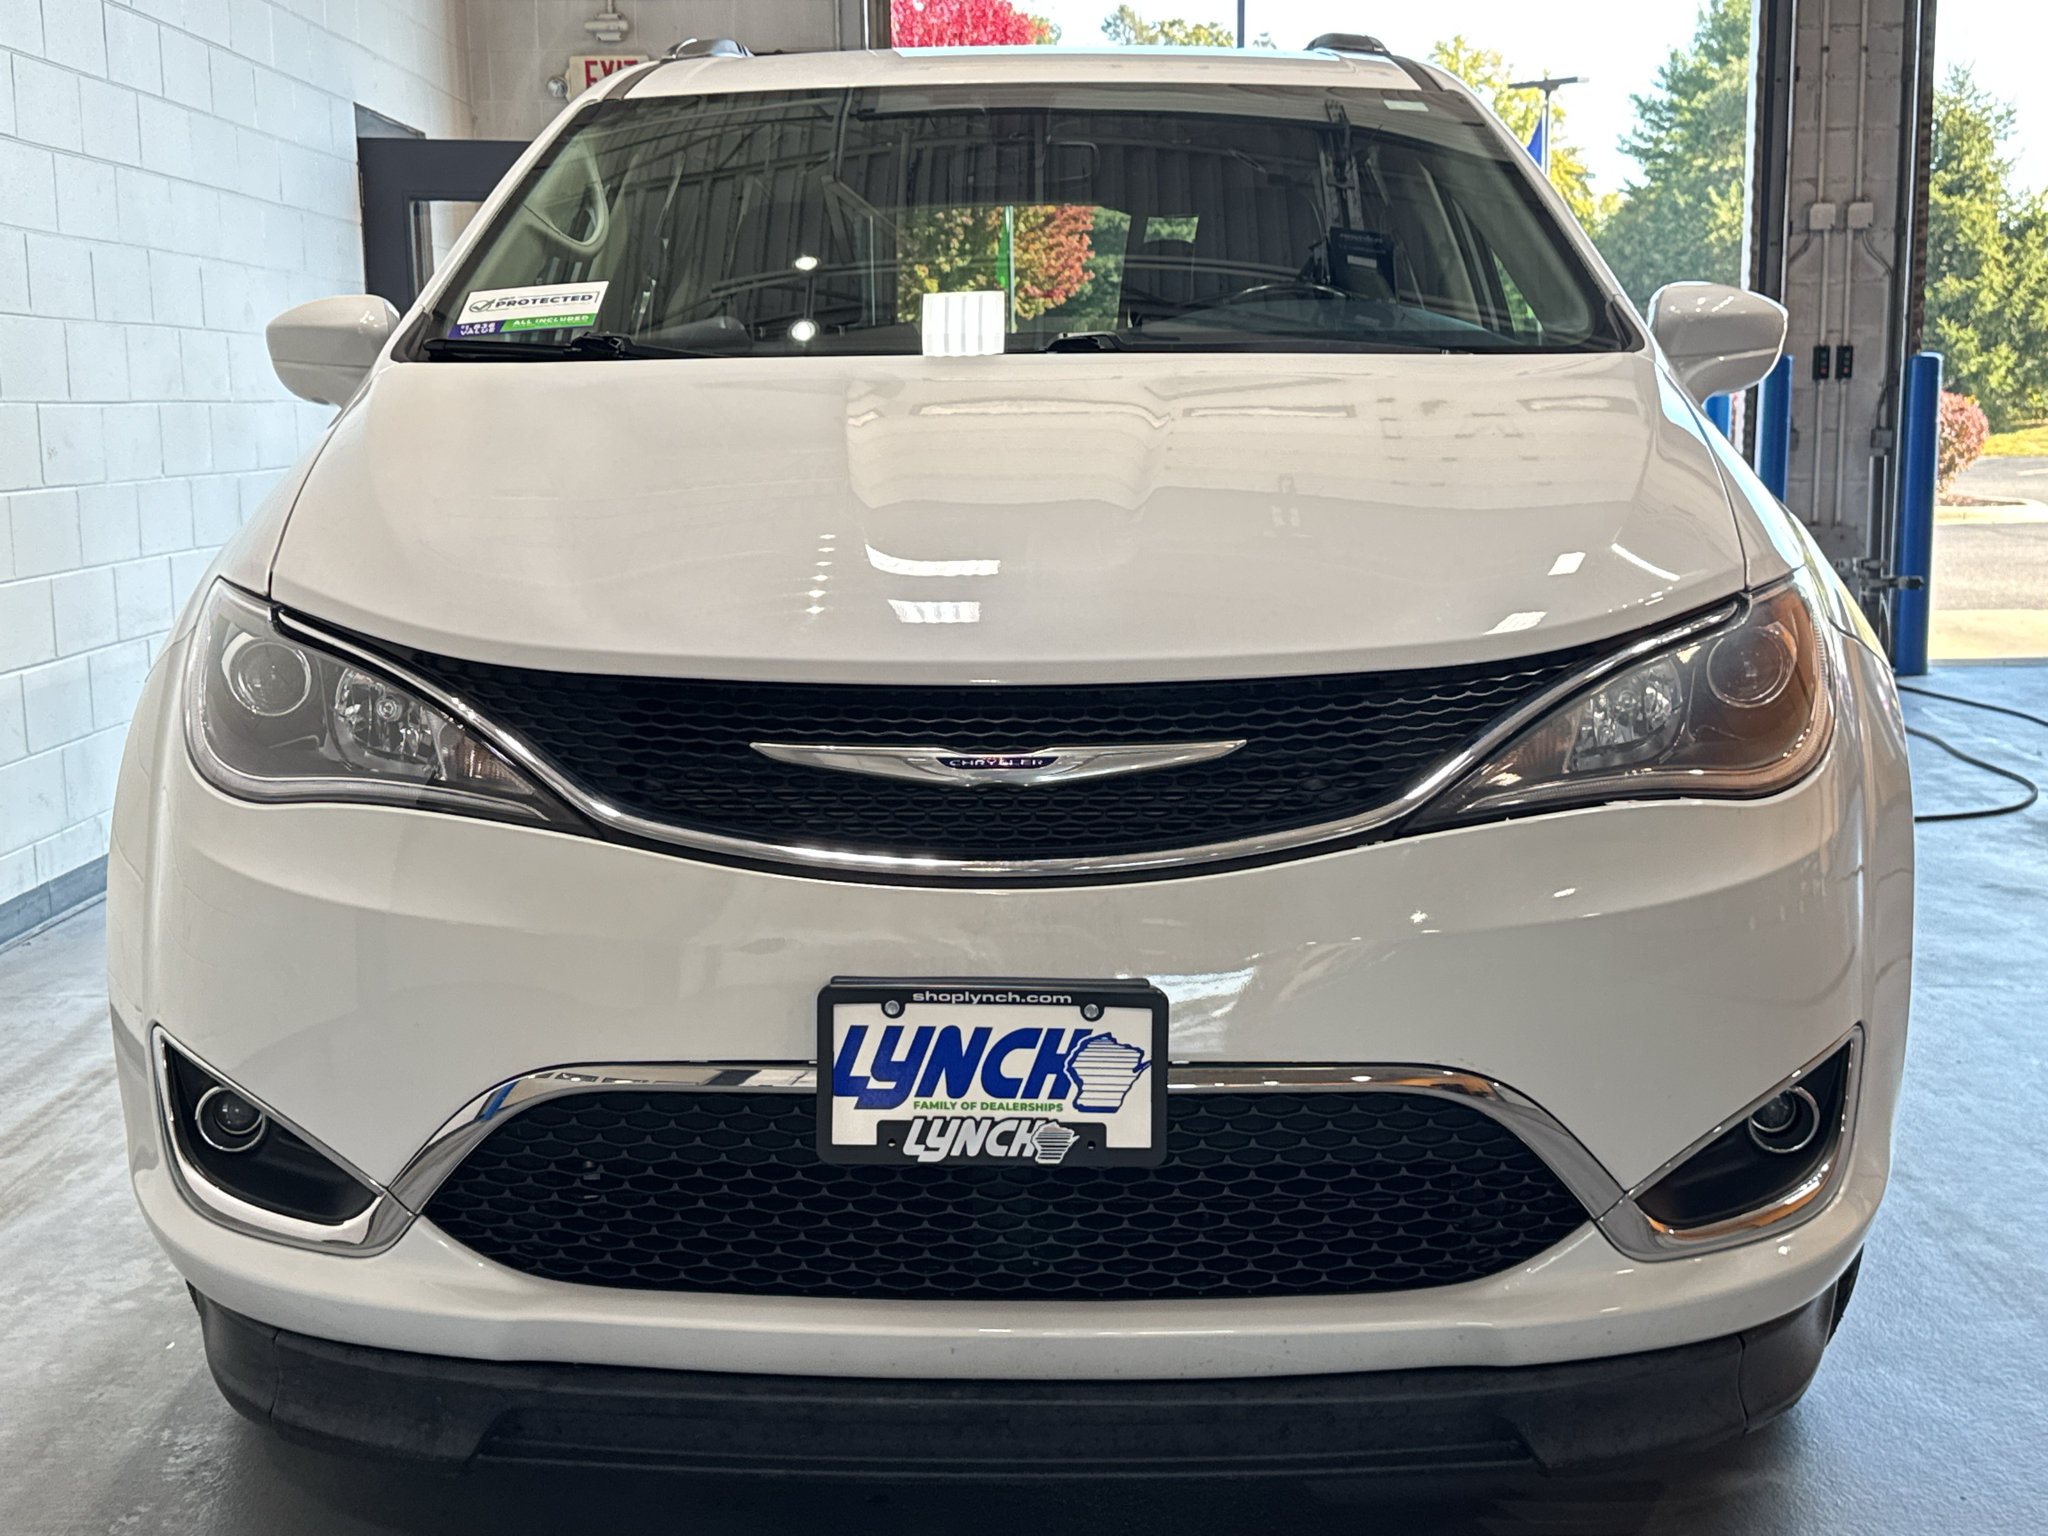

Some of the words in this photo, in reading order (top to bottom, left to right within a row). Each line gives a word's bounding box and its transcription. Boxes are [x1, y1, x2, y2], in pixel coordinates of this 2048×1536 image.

[496, 294, 593, 308] PROTECTED
[513, 318, 532, 326] ALL
[535, 315, 589, 324] INCLUDED
[460, 327, 495, 336] VALUE
[912, 991, 1072, 1005] shoplynch.com
[833, 1025, 1093, 1111] LYNCH
[913, 1100, 956, 1111] FAMILY
[960, 1101, 977, 1111] OF
[980, 1101, 1063, 1112] DEALERSHIPS
[903, 1117, 1046, 1162] LYNCH
